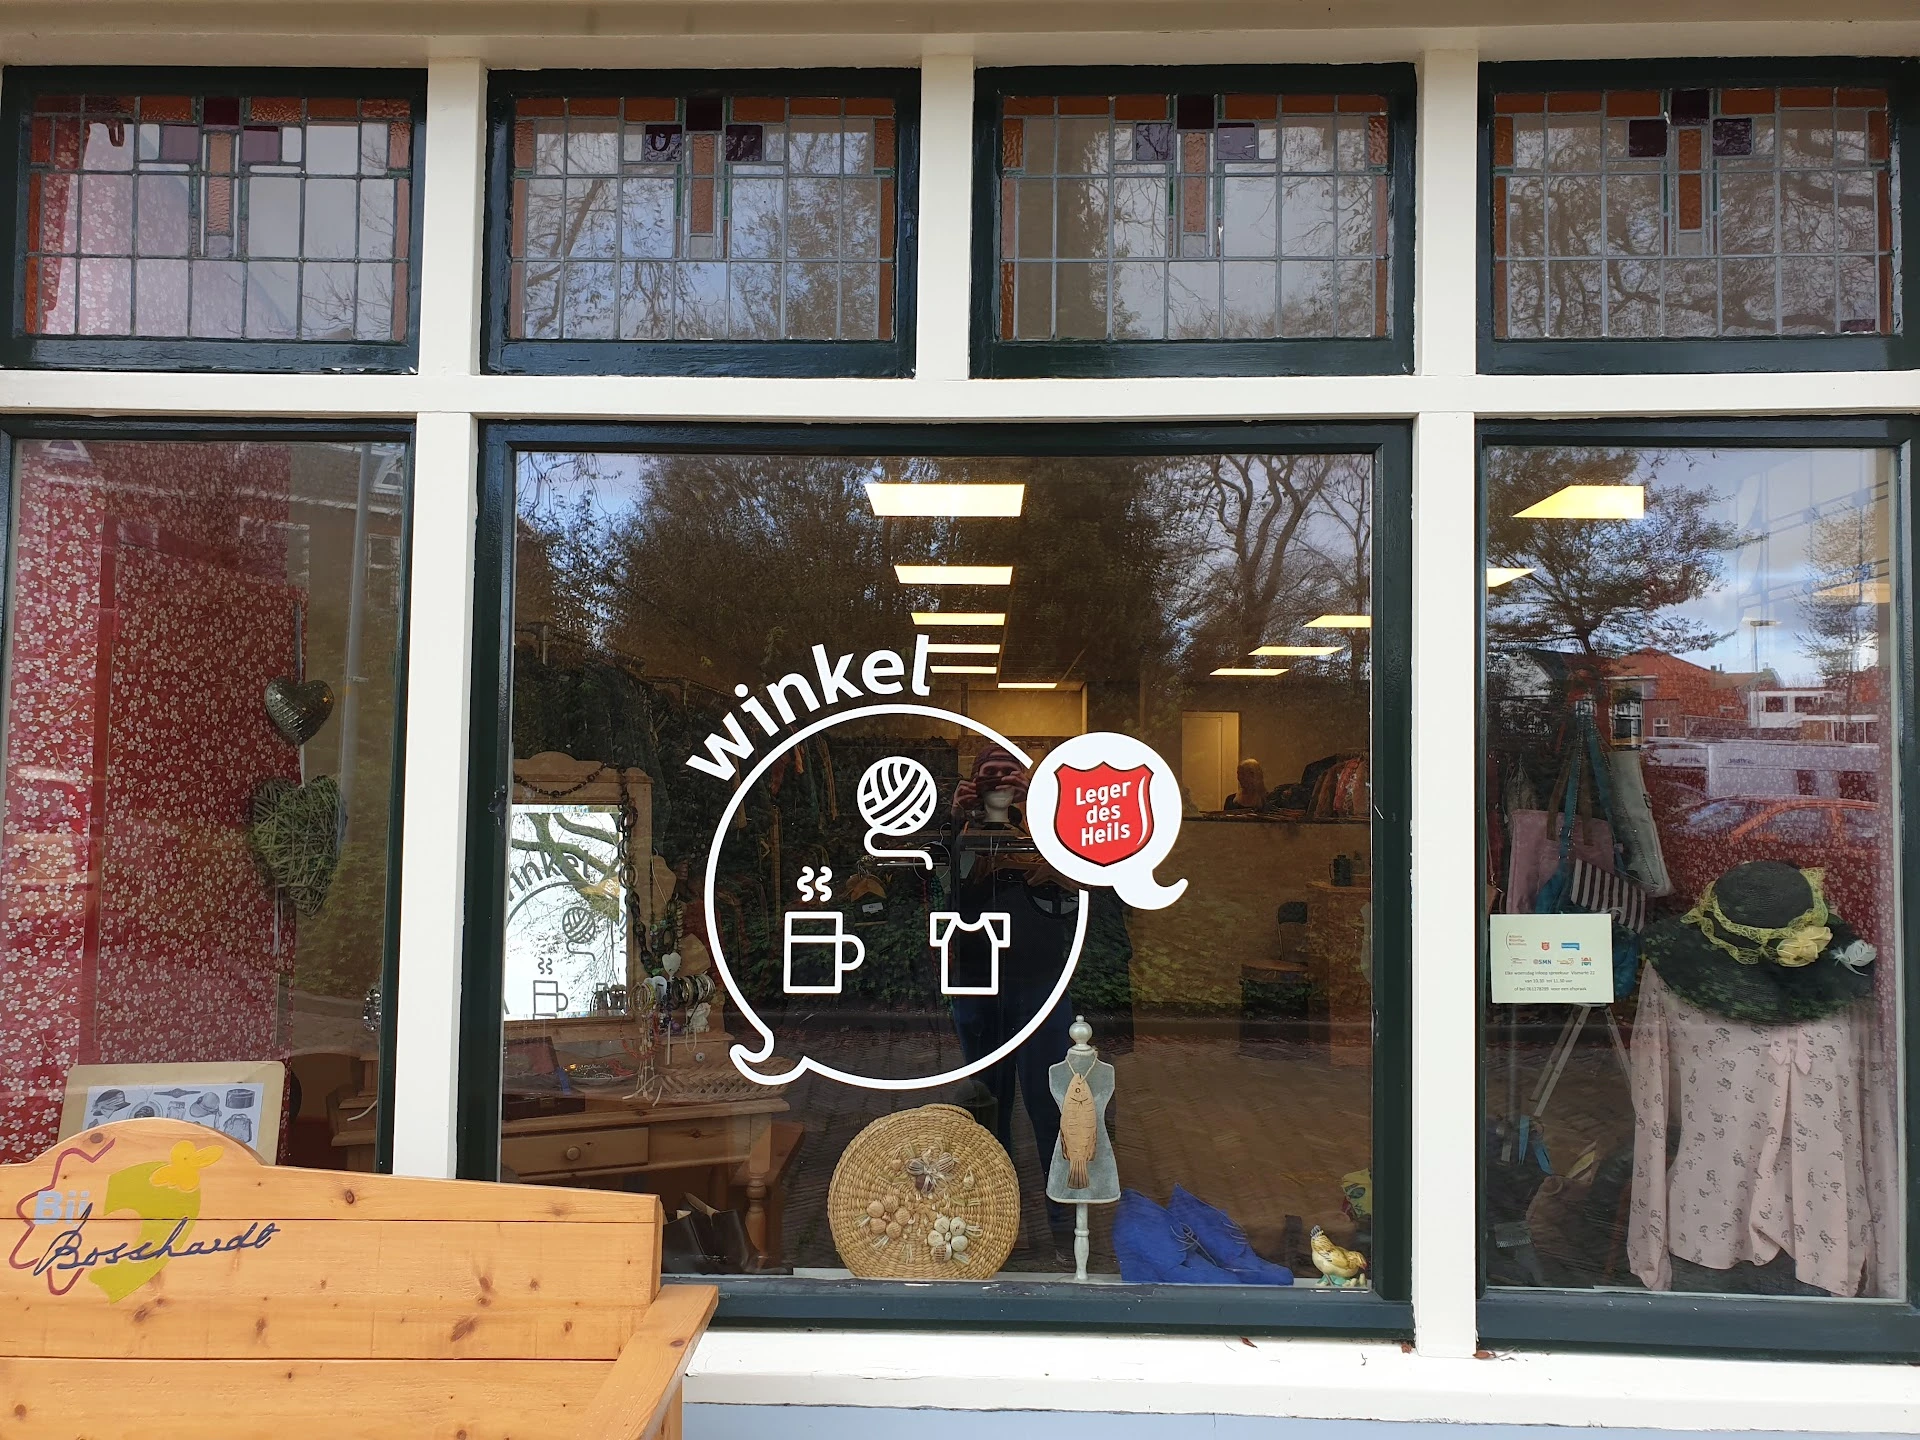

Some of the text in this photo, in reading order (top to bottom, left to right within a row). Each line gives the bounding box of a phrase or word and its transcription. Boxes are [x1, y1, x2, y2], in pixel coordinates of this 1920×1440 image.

[686, 634, 930, 782] winkel
[1075, 781, 1131, 806] Leger
[1086, 804, 1121, 824] des
[1080, 821, 1131, 847] Heils
[34, 1190, 91, 1232] Bij
